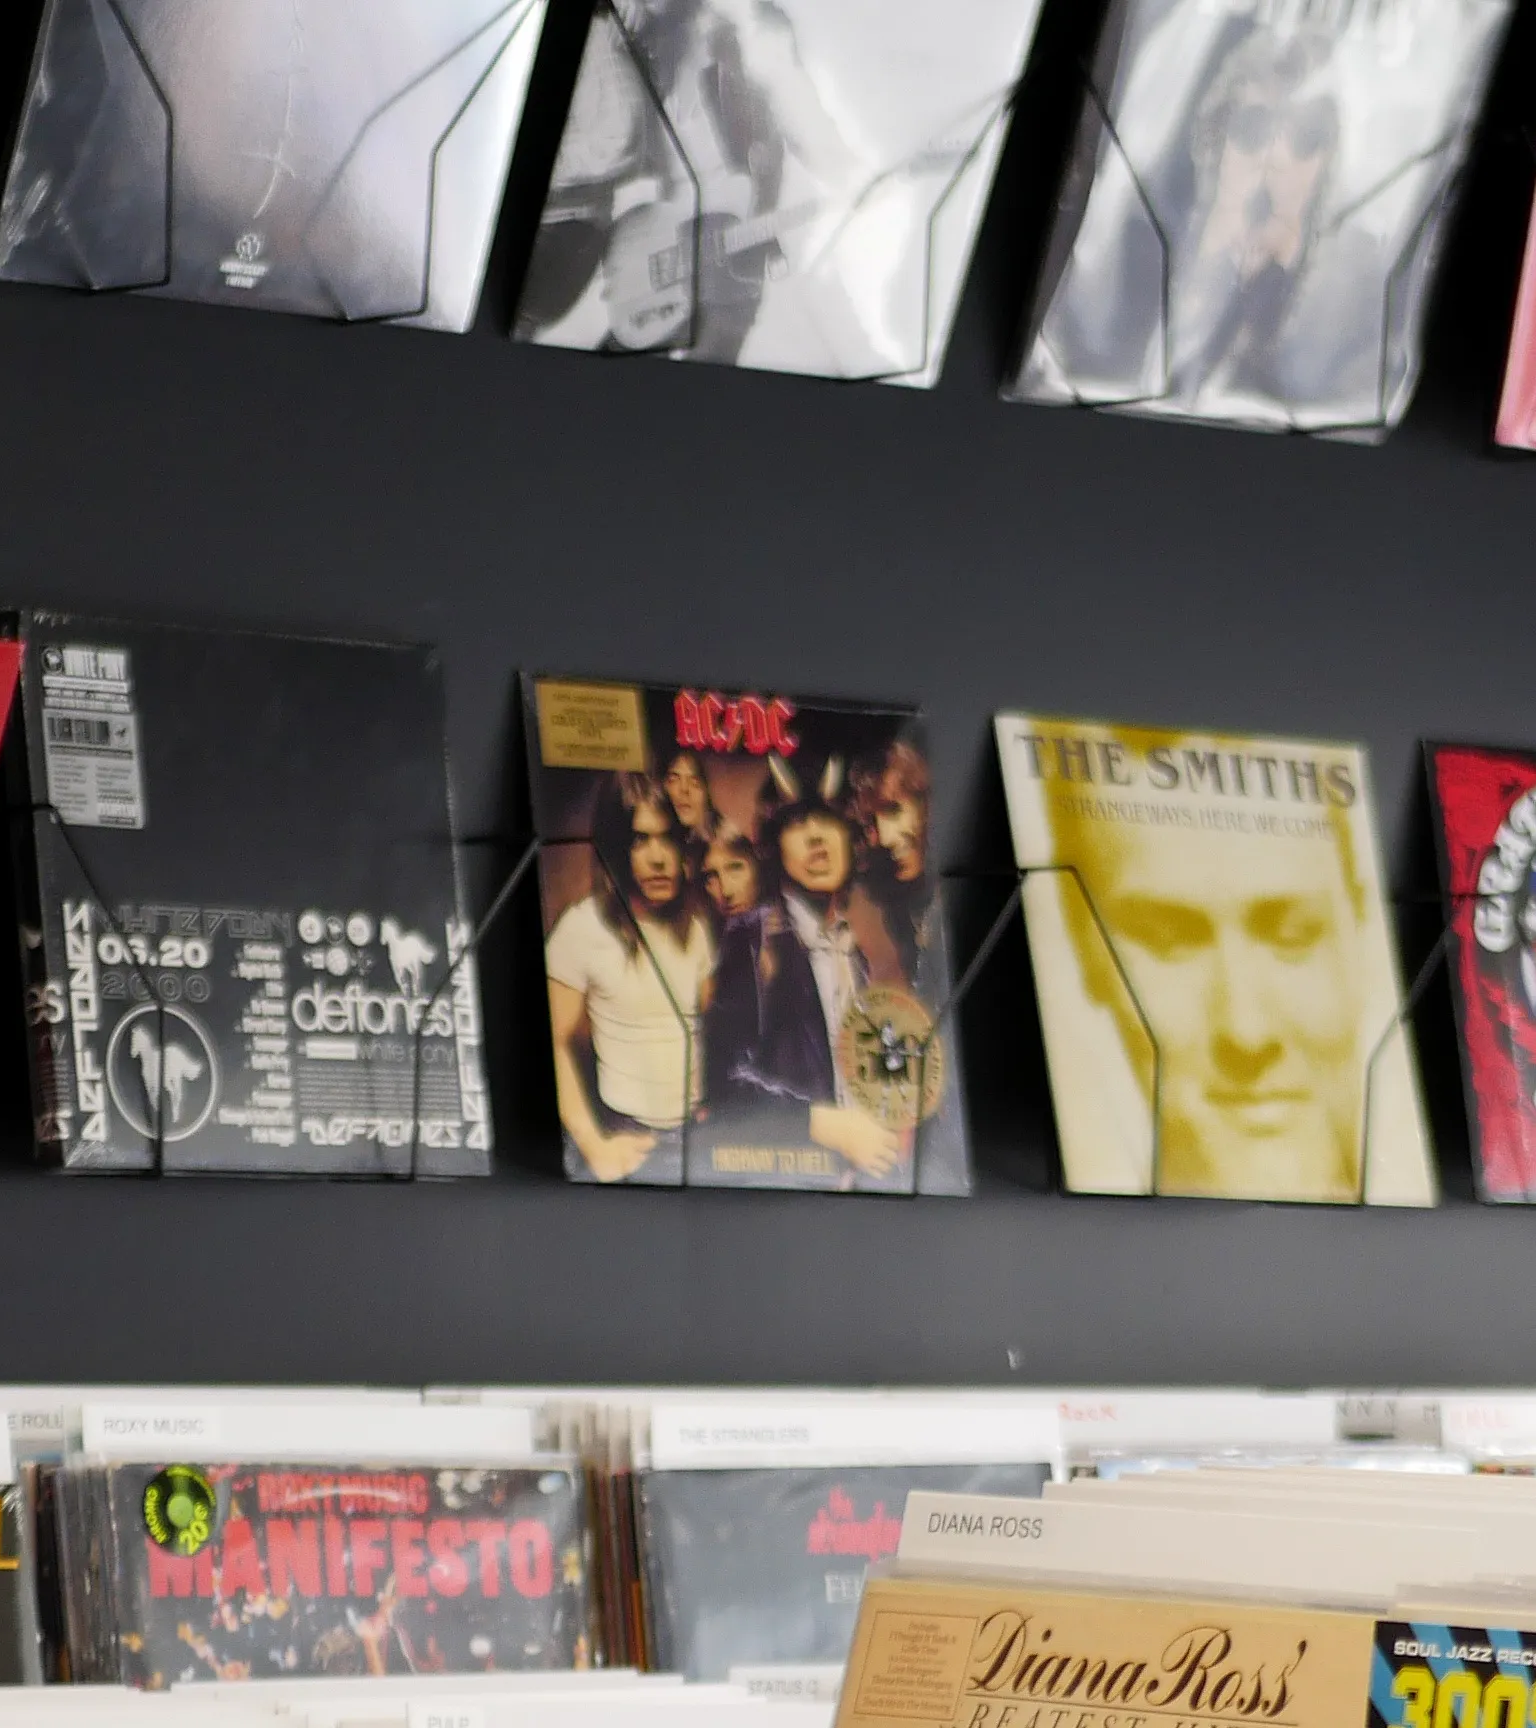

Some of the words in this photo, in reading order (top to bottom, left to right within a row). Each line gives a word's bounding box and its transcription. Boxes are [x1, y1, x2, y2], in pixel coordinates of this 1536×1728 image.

[1013, 734, 1134, 788] THE
[1147, 745, 1358, 810] SMITHS
[103, 1418, 150, 1436] ROXY
[153, 1418, 205, 1437] MUSIC
[927, 1512, 985, 1536] DIANA
[988, 1515, 1044, 1540] ROSS
[144, 1513, 556, 1600] MANIFESTO
[964, 1609, 1149, 1703] Diana
[1393, 1640, 1441, 1658] SOUL
[1445, 1643, 1494, 1663] JAZZ
[746, 1679, 803, 1697] STATUS
